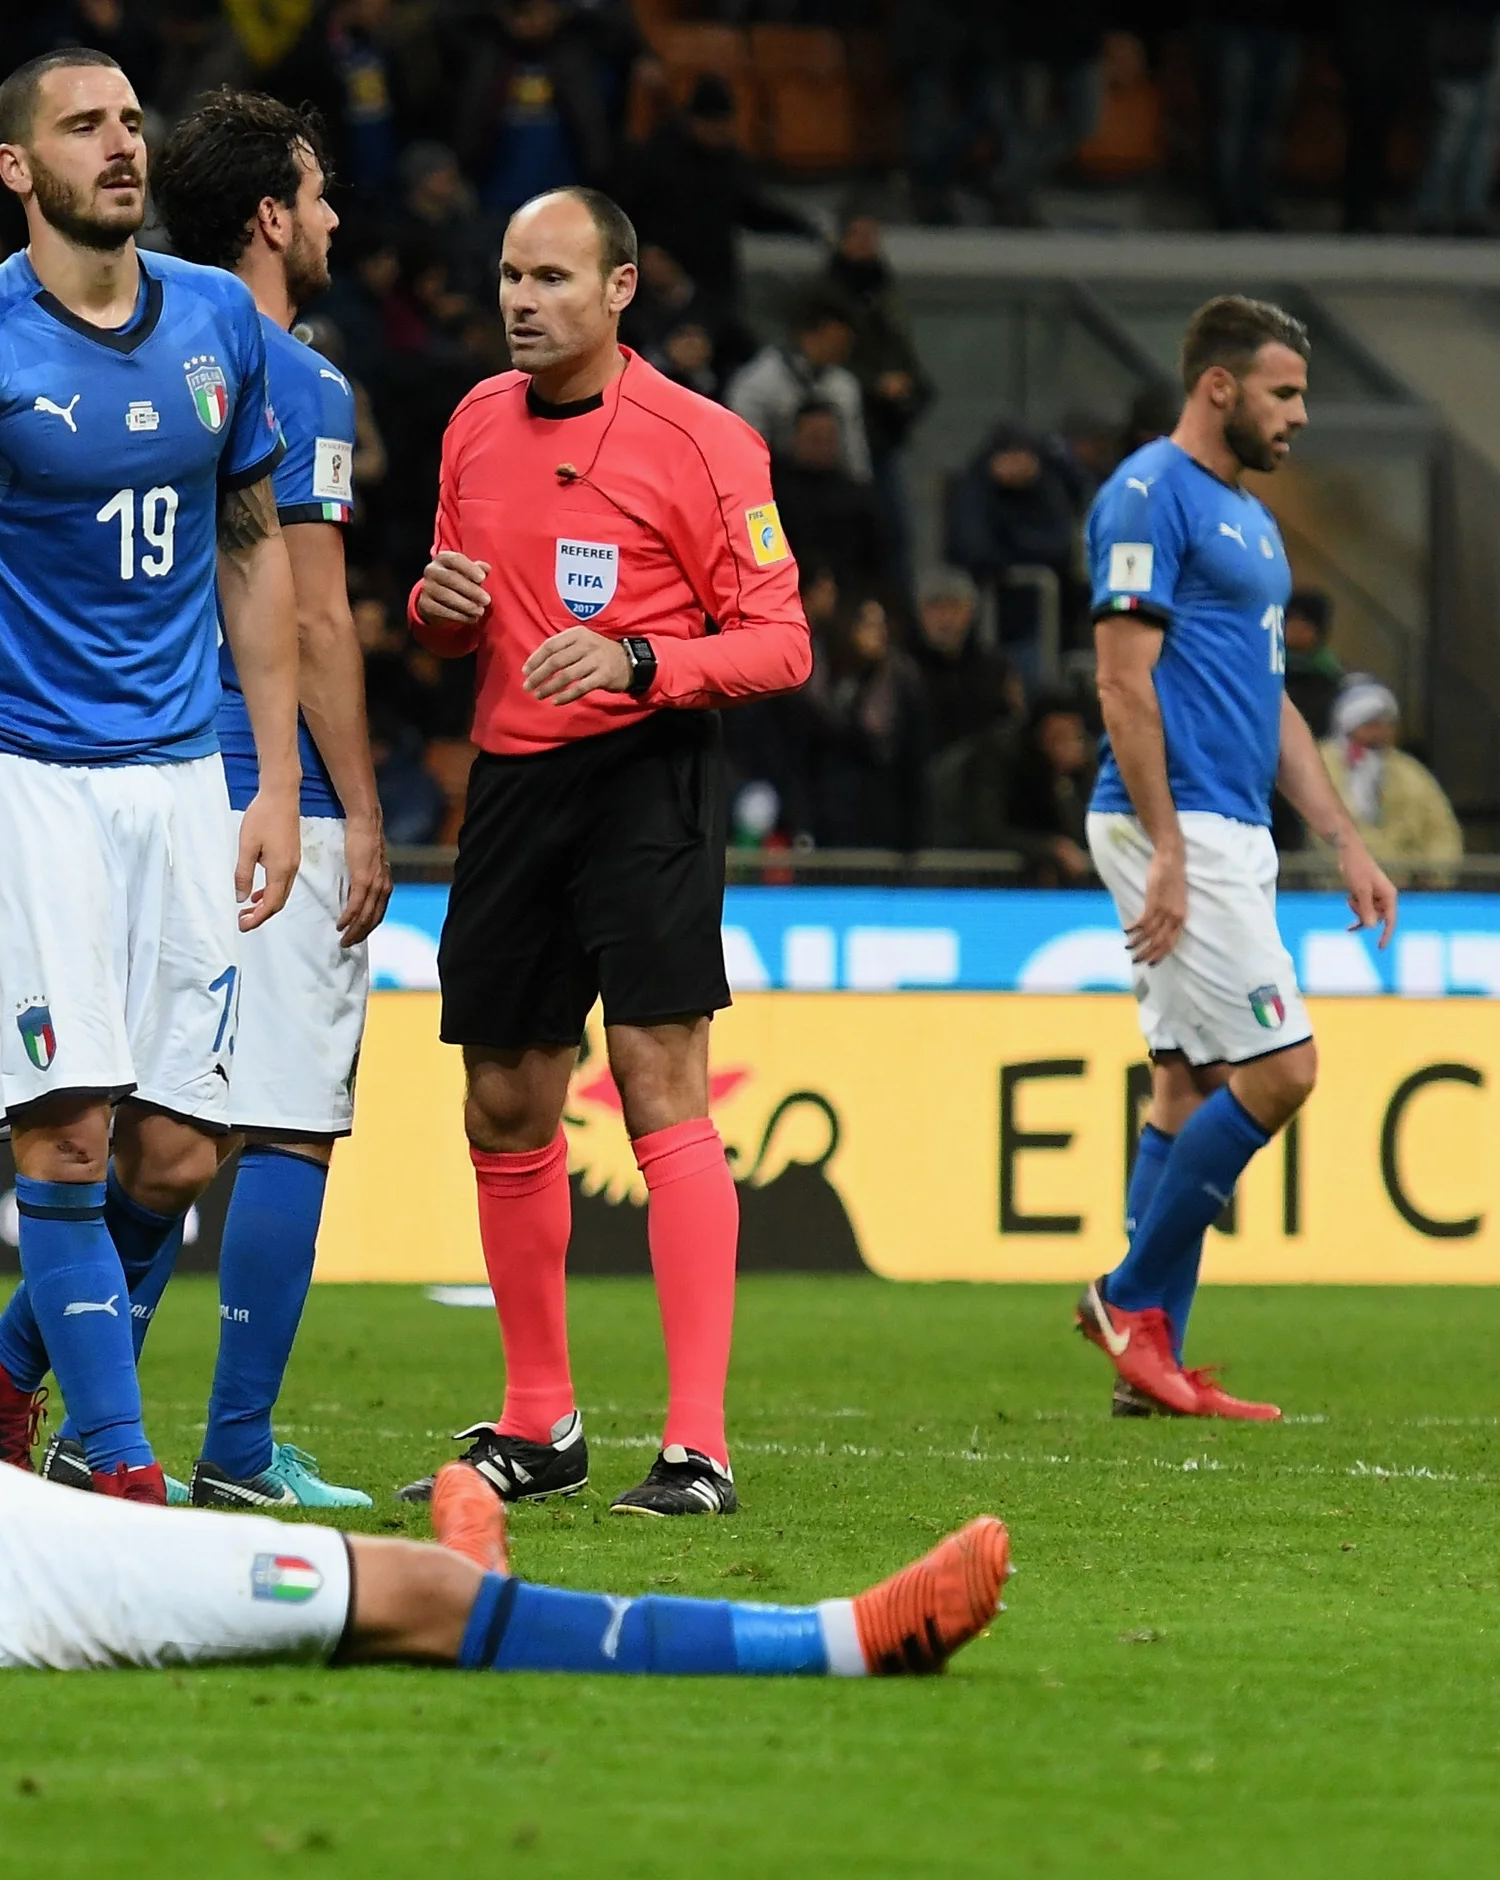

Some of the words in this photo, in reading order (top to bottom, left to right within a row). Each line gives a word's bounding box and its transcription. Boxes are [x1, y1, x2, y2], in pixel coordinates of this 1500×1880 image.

[191, 370, 221, 389] ITALIA
[748, 511, 764, 521] FIFA
[96, 485, 179, 580] 19
[560, 544, 613, 560] REFEREE
[567, 572, 604, 589] FIFA
[572, 603, 596, 614] 2017
[208, 965, 240, 1056] 1
